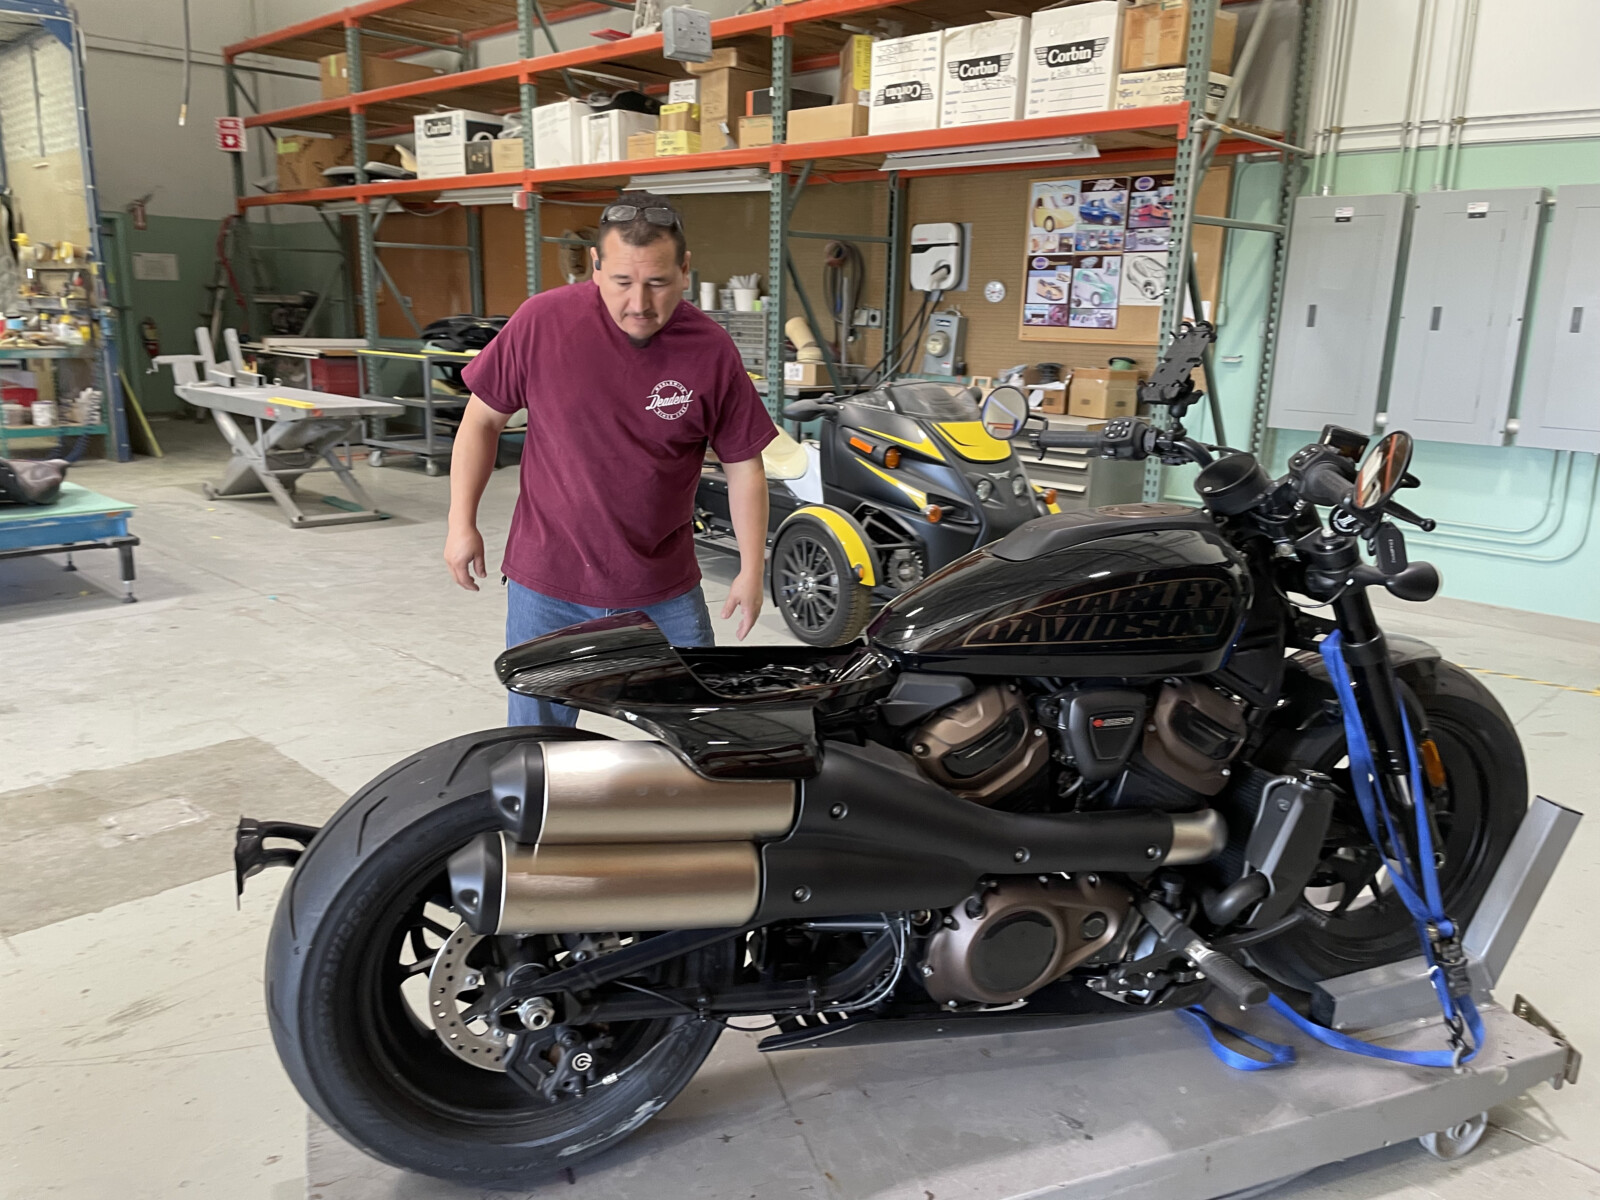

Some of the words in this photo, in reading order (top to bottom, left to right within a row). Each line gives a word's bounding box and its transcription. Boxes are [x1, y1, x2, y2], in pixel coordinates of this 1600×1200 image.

[1047, 45, 1093, 64] Corbin
[958, 61, 999, 78] Corbin
[885, 84, 922, 99] Corbin
[645, 389, 694, 411] Deadend
